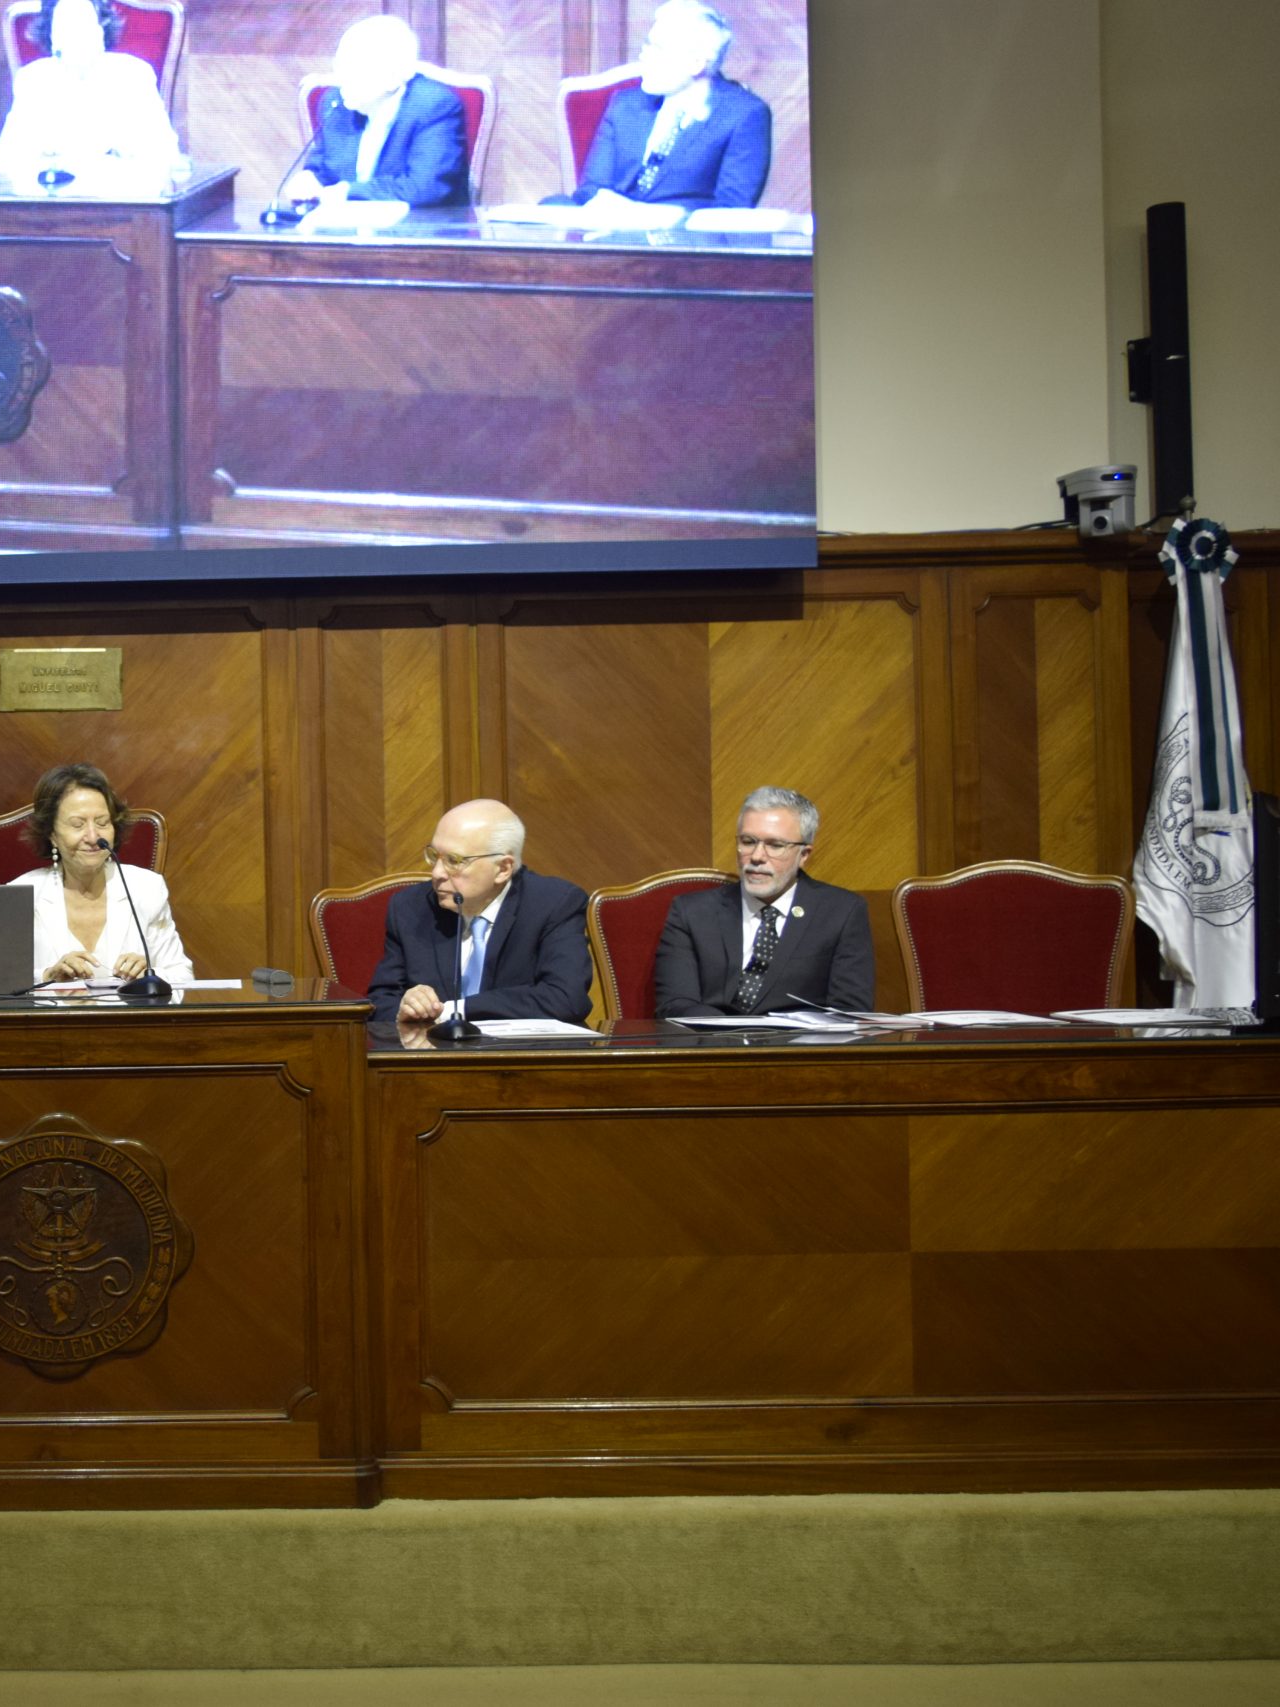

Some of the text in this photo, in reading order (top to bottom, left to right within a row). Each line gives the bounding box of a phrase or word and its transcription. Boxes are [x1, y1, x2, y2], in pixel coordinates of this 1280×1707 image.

[99, 1145, 124, 1171] DE
[121, 1168, 174, 1244] MEDICINA
[71, 1339, 96, 1359] EM
[98, 1316, 135, 1350] 1829
